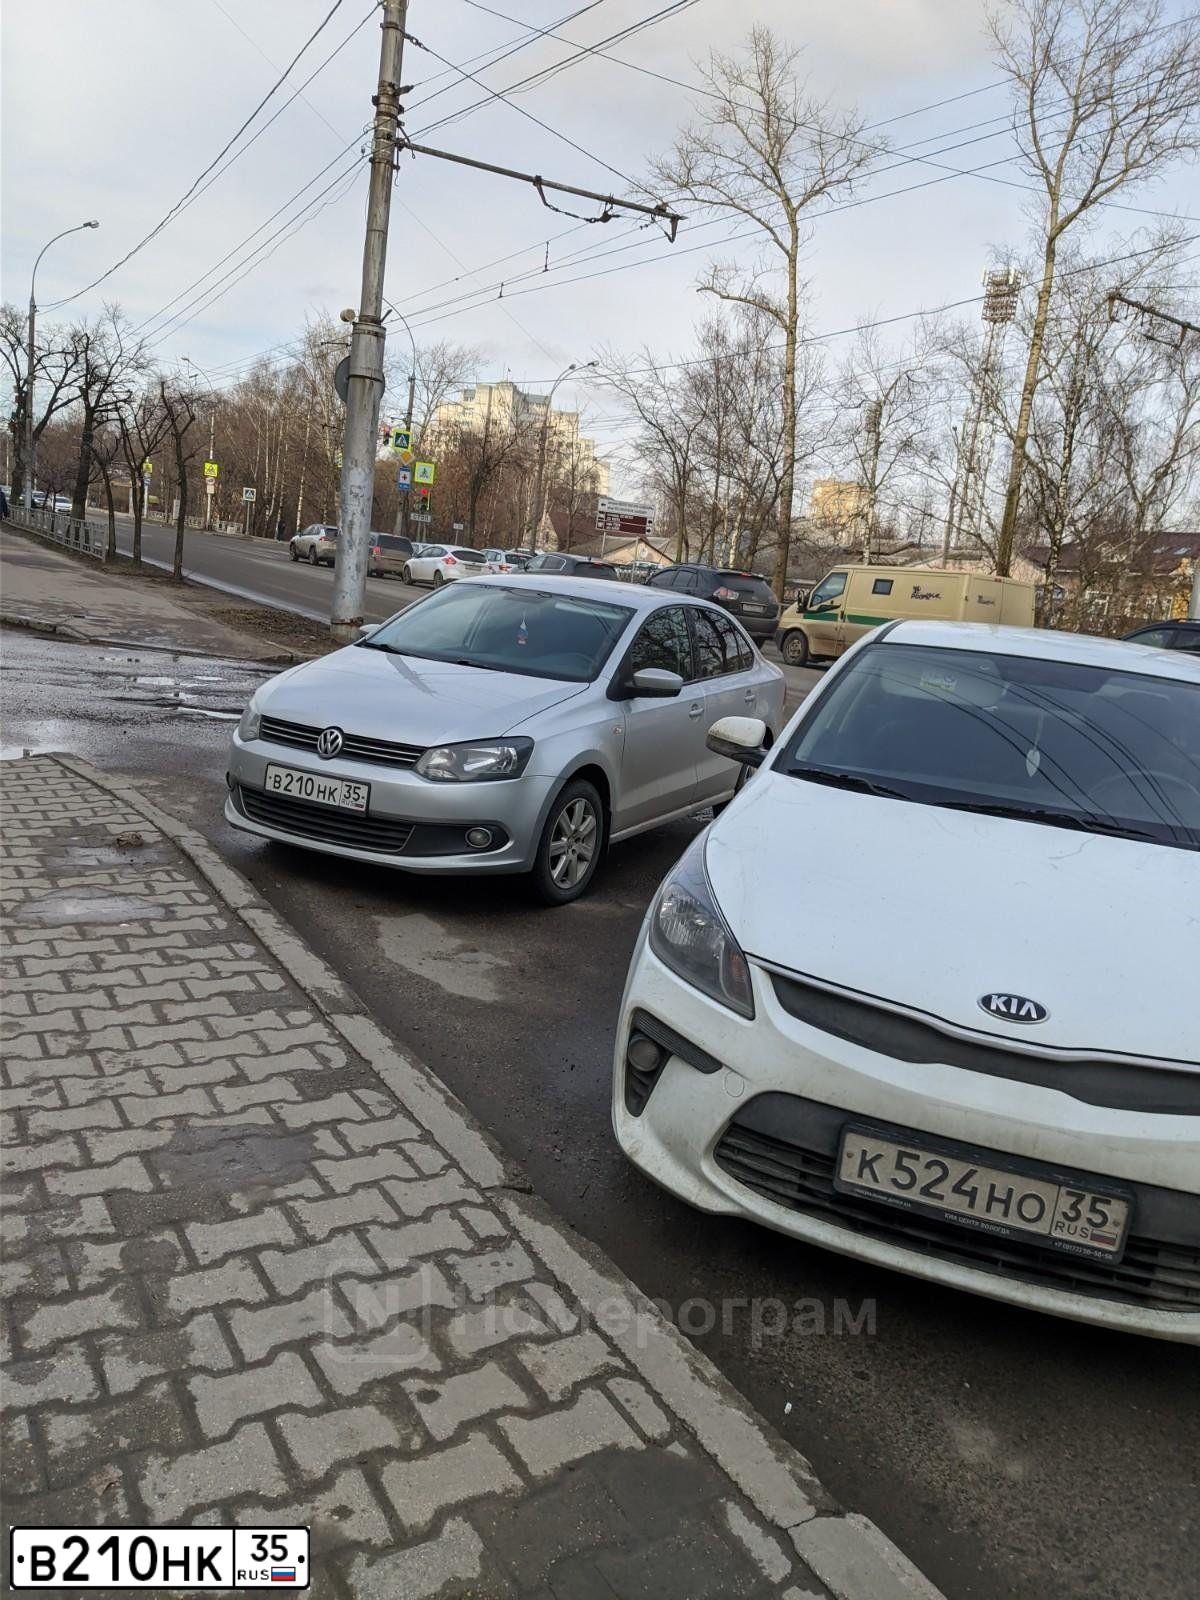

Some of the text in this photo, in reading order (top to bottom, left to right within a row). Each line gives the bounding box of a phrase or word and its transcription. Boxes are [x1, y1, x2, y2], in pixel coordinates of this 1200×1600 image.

[273, 772, 361, 803] В210НК 35
[990, 994, 1038, 1019] KIA
[857, 1149, 1111, 1229] К524НО 35
[1055, 1220, 1089, 1239] RUS
